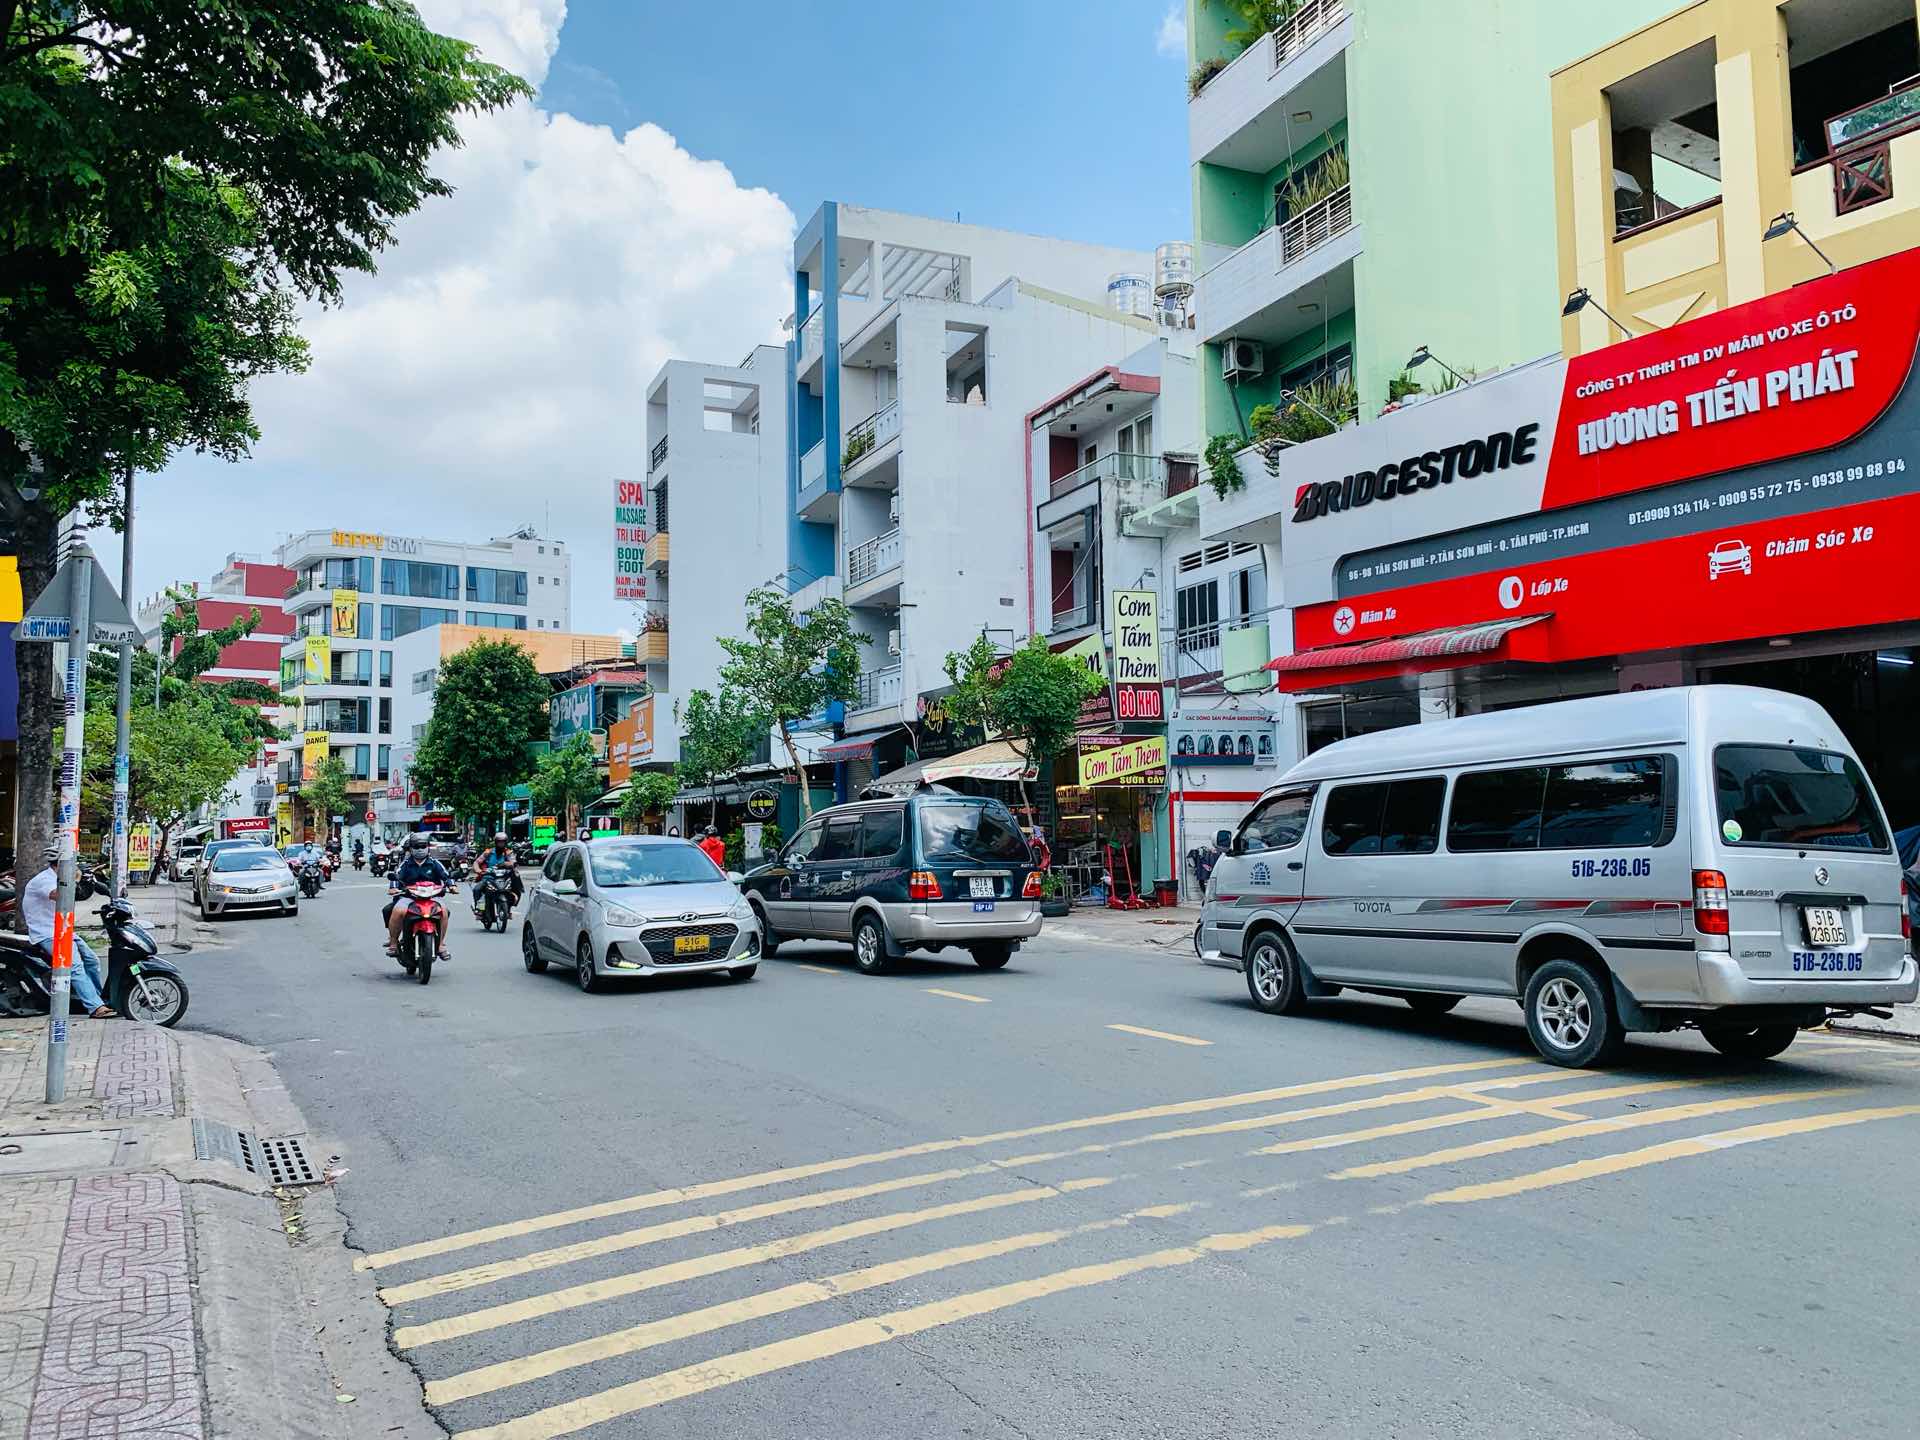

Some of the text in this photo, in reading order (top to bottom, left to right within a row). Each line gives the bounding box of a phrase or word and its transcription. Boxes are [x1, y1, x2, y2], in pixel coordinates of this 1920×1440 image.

[1576, 378, 1614, 398] CÔNG
[1616, 372, 1635, 386] TY
[1638, 361, 1675, 381] TNHH
[1678, 353, 1700, 369] TM
[1728, 333, 1764, 355] MÂM
[1791, 318, 1814, 336] XE
[1816, 310, 1830, 328] Ô
[1832, 303, 1857, 324] TÔ
[1577, 348, 1859, 456] HƯƠNG TIẾN PHÁT
[1291, 422, 1540, 523] BRIDGESTONE
[619, 480, 643, 506] SPA
[1672, 502, 1691, 517] 134
[1692, 498, 1710, 513] 114
[1718, 490, 1748, 508] 0909
[1750, 486, 1765, 501] 55
[1768, 482, 1783, 498] 72
[1786, 479, 1802, 494] 75
[1812, 472, 1844, 489] 0938
[1846, 467, 1864, 482] 99
[1866, 462, 1883, 477] 88
[1886, 459, 1906, 474] 94
[616, 507, 646, 525] MASSAGE
[616, 528, 628, 544] TRỊ
[1765, 525, 1874, 557] Chăm Sóc Xe
[617, 547, 645, 561] BODY
[618, 561, 645, 574] FOOT
[1530, 577, 1569, 597] Lốp Xe
[1118, 595, 1152, 617] Cơm
[1384, 606, 1397, 621] Xe
[1121, 623, 1153, 647] Tấm
[1118, 656, 1158, 678] Thèm
[1119, 685, 1136, 718] BÒ
[1137, 689, 1161, 718] KHO
[305, 736, 328, 745] DANCE
[1084, 744, 1161, 781] Cơm Tấm Thèm
[231, 820, 264, 828] CADIVI
[1571, 857, 1651, 878] 51B-236.05
[1353, 902, 1391, 913] TOYOTA
[1814, 910, 1834, 926] 51B
[1811, 927, 1846, 943] 236.05
[1793, 952, 1863, 972] 51B-236.05
